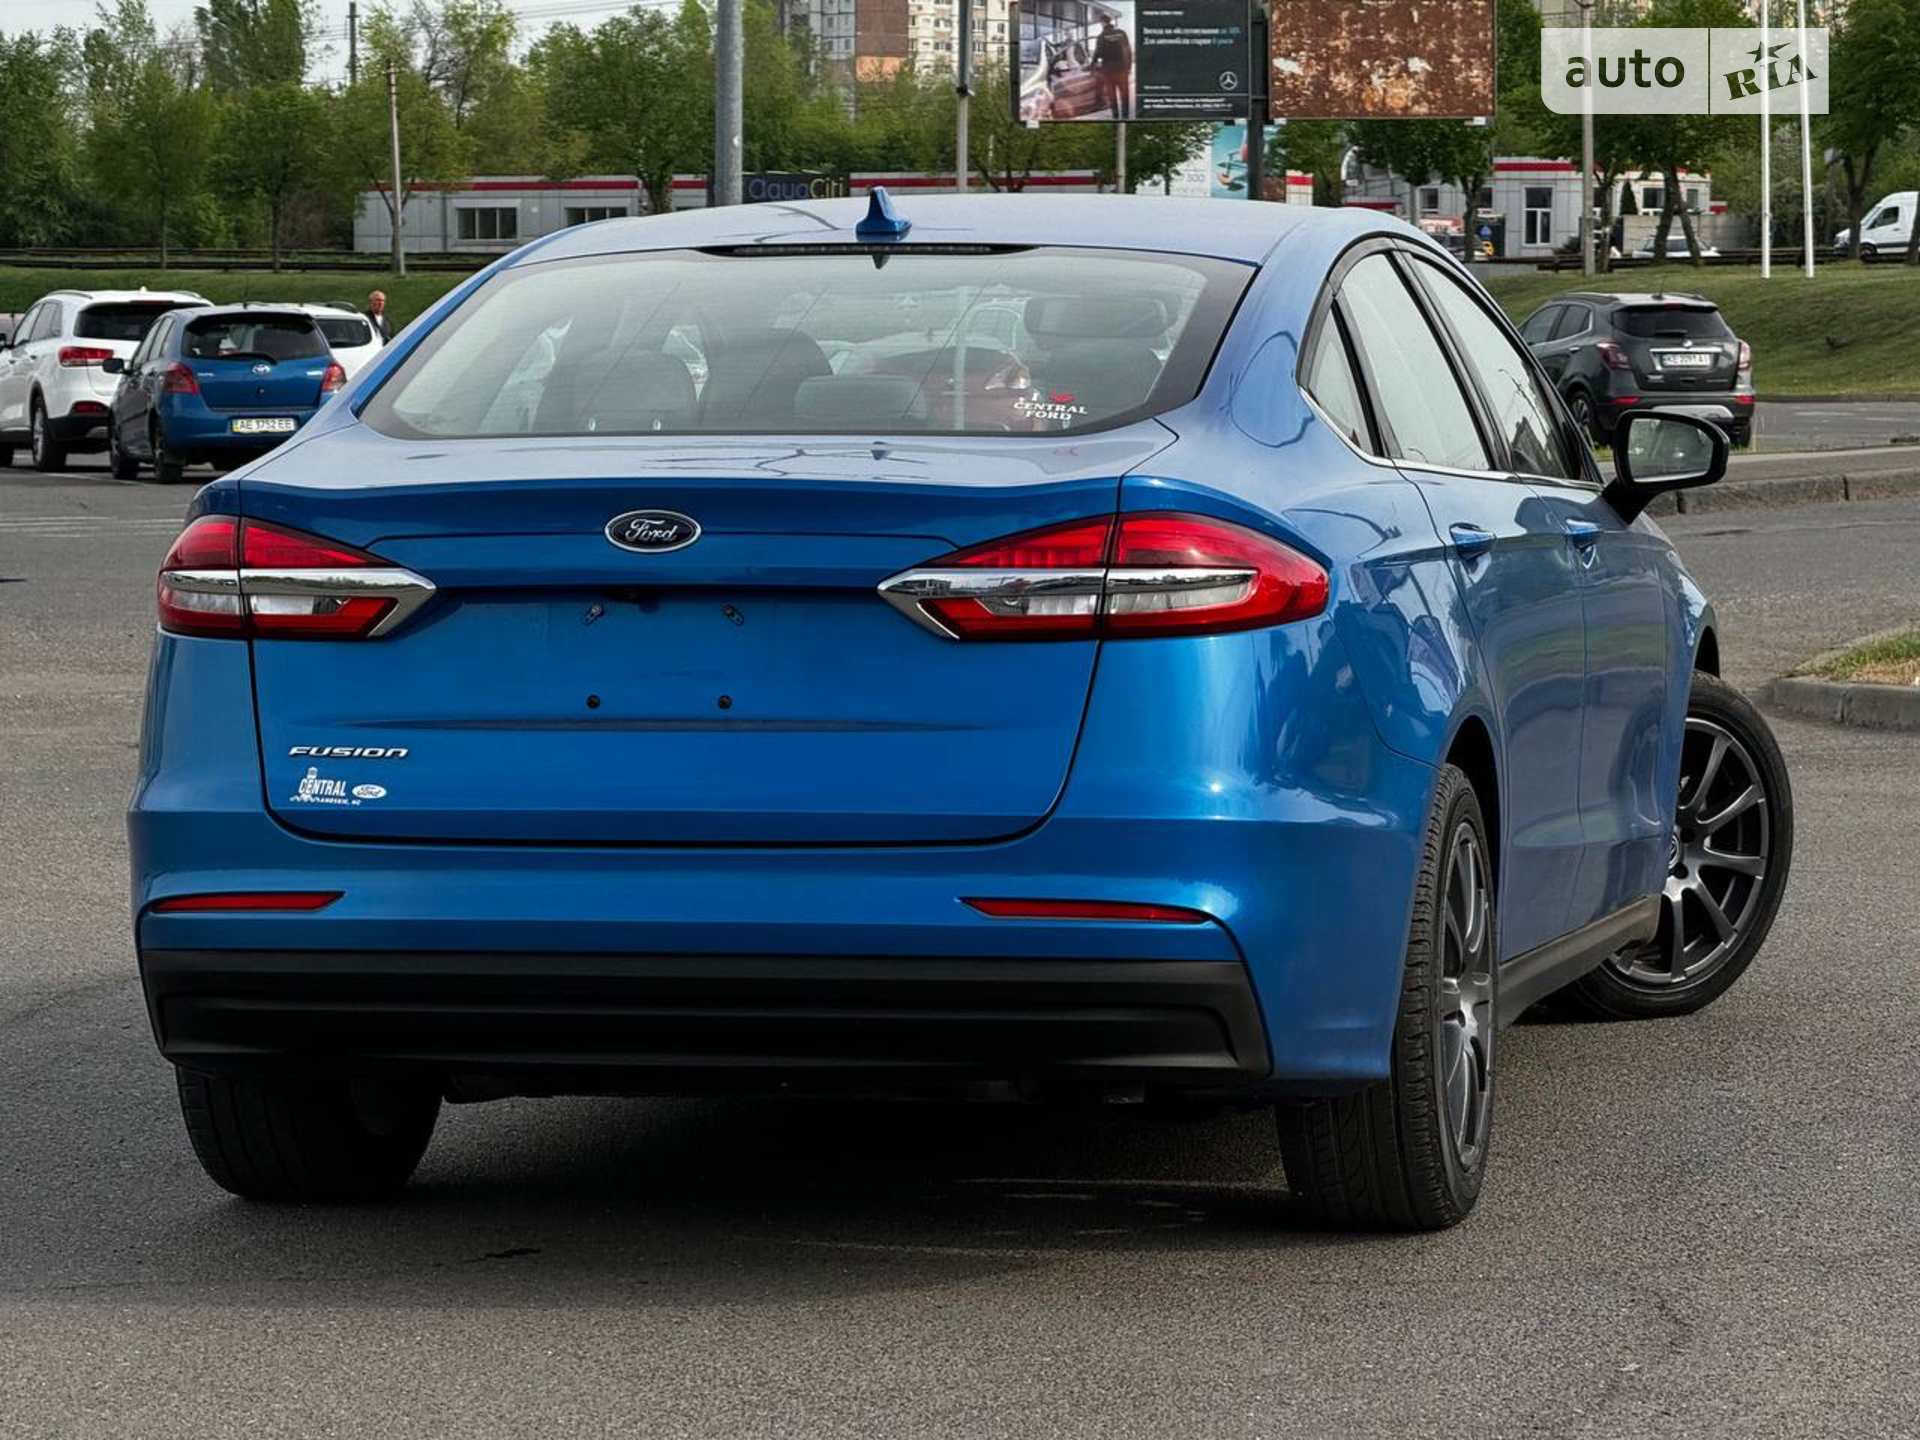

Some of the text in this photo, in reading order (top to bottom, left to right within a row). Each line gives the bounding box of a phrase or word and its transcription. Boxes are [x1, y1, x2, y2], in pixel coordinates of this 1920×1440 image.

[1013, 402, 1088, 414] CENTRAL
[1025, 410, 1072, 420] FORD
[625, 518, 678, 541] Ford
[289, 746, 409, 757] FUSION
[298, 778, 347, 796] CENTRAL
